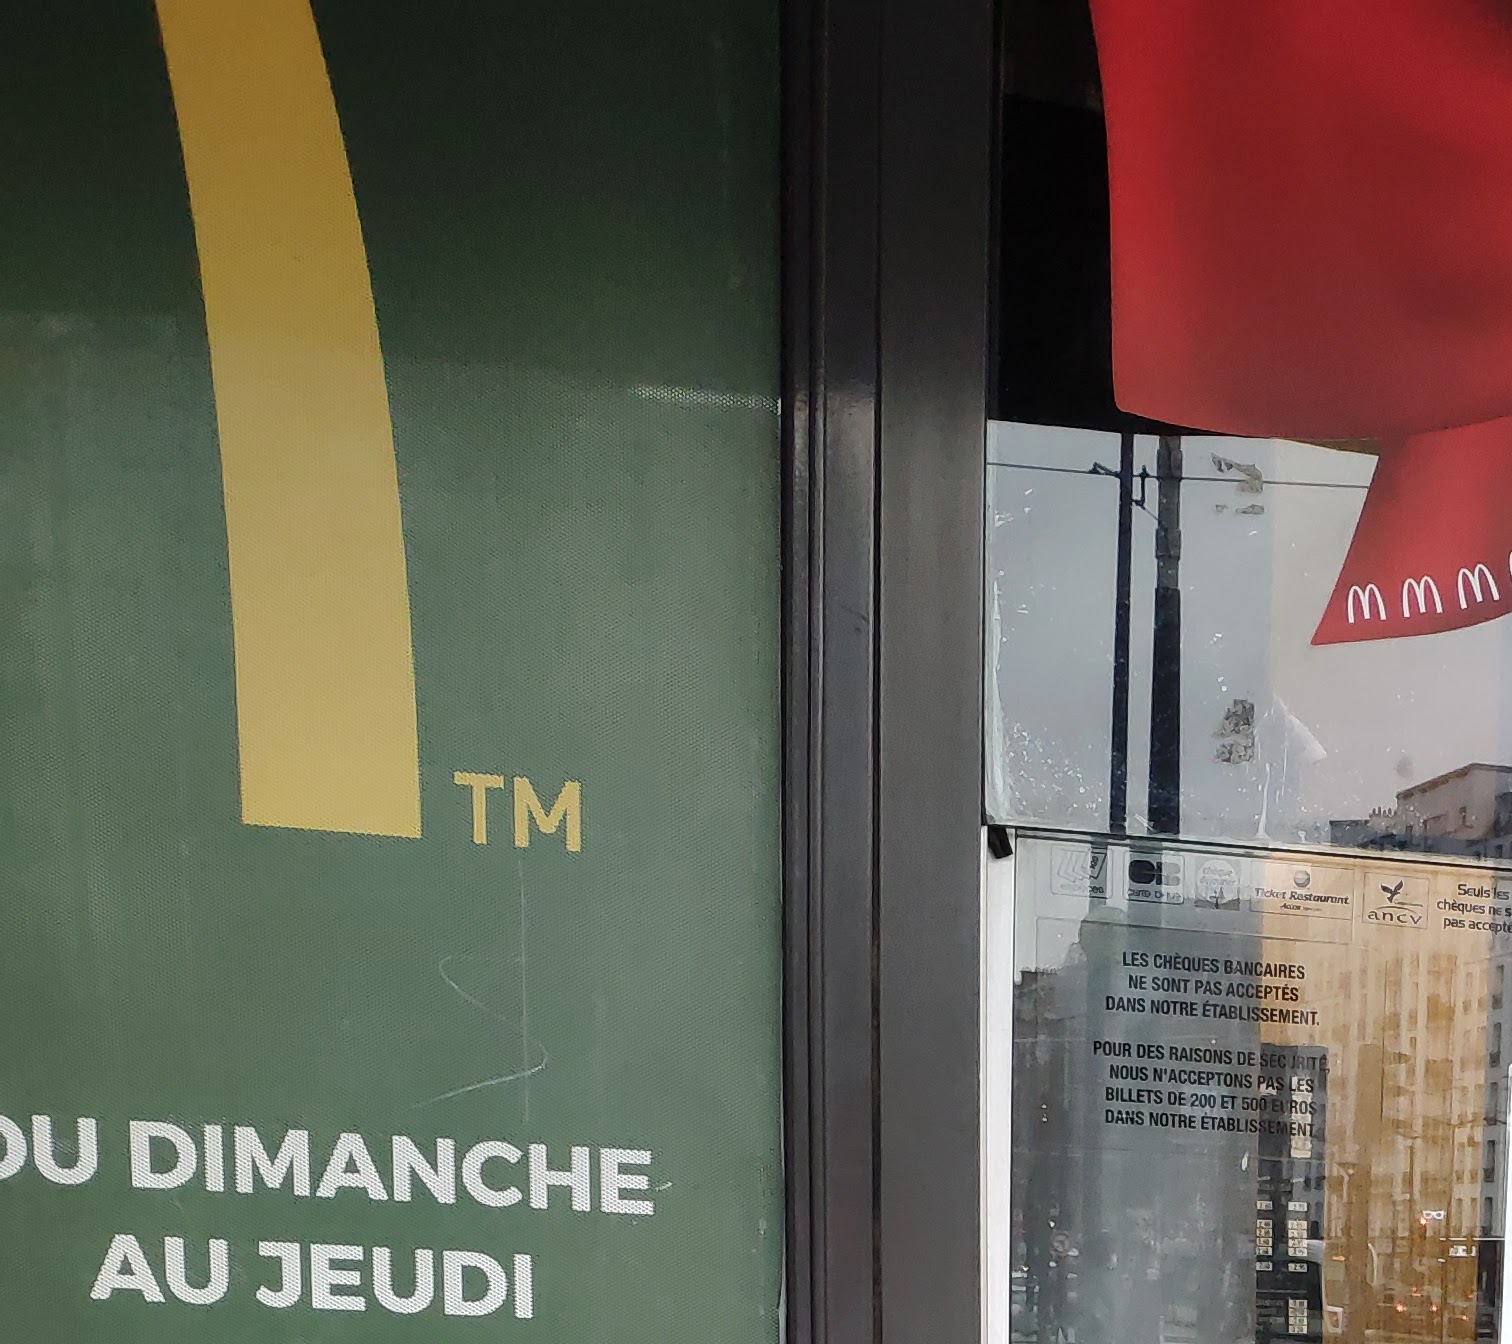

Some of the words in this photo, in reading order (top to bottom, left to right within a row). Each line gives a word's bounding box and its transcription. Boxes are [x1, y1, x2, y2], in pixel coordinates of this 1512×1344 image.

[453, 770, 582, 853] TM
[1289, 891, 1350, 904] Restaurant
[1457, 883, 1491, 899] Seuls
[1367, 910, 1423, 925] ancv
[1437, 898, 1486, 915] chèques
[1443, 917, 1466, 930] pas
[1123, 951, 1149, 967] LES
[1154, 952, 1220, 974] CHÈQUES
[1224, 959, 1305, 980] BANCAIRES
[1128, 974, 1148, 990] NE
[1151, 976, 1191, 993] SONT
[1195, 980, 1222, 996] PAS
[1226, 982, 1299, 1002] ACCEPTÉS
[1105, 995, 1146, 1013] DANS
[1150, 999, 1198, 1017] NOTRE
[1202, 1000, 1320, 1026] ÉTABLISSEMENT.
[1093, 1040, 1132, 1057] POUR
[1136, 1043, 1165, 1060] DES
[1169, 1046, 1233, 1065] RAISONS
[1237, 1051, 1256, 1067] DE
[1109, 1064, 1149, 1082] NOUS
[1153, 1067, 1253, 1090] N'ACCEPTONS
[1257, 1075, 1285, 1092] PAS
[1289, 1076, 1315, 1093] LES
[1105, 1087, 1163, 1105] BILLETS
[1167, 1091, 1187, 1107] DE
[1190, 1093, 1217, 1109] 200
[1220, 1094, 1238, 1110] ET
[1241, 1096, 1267, 1112] 500
[1105, 1109, 1145, 1126] DANS
[1149, 1112, 1197, 1130] NOTRE
[130, 1119, 654, 1216] DIMANCHE
[90, 1234, 230, 1306] AU
[255, 1240, 534, 1319] JEUDI
